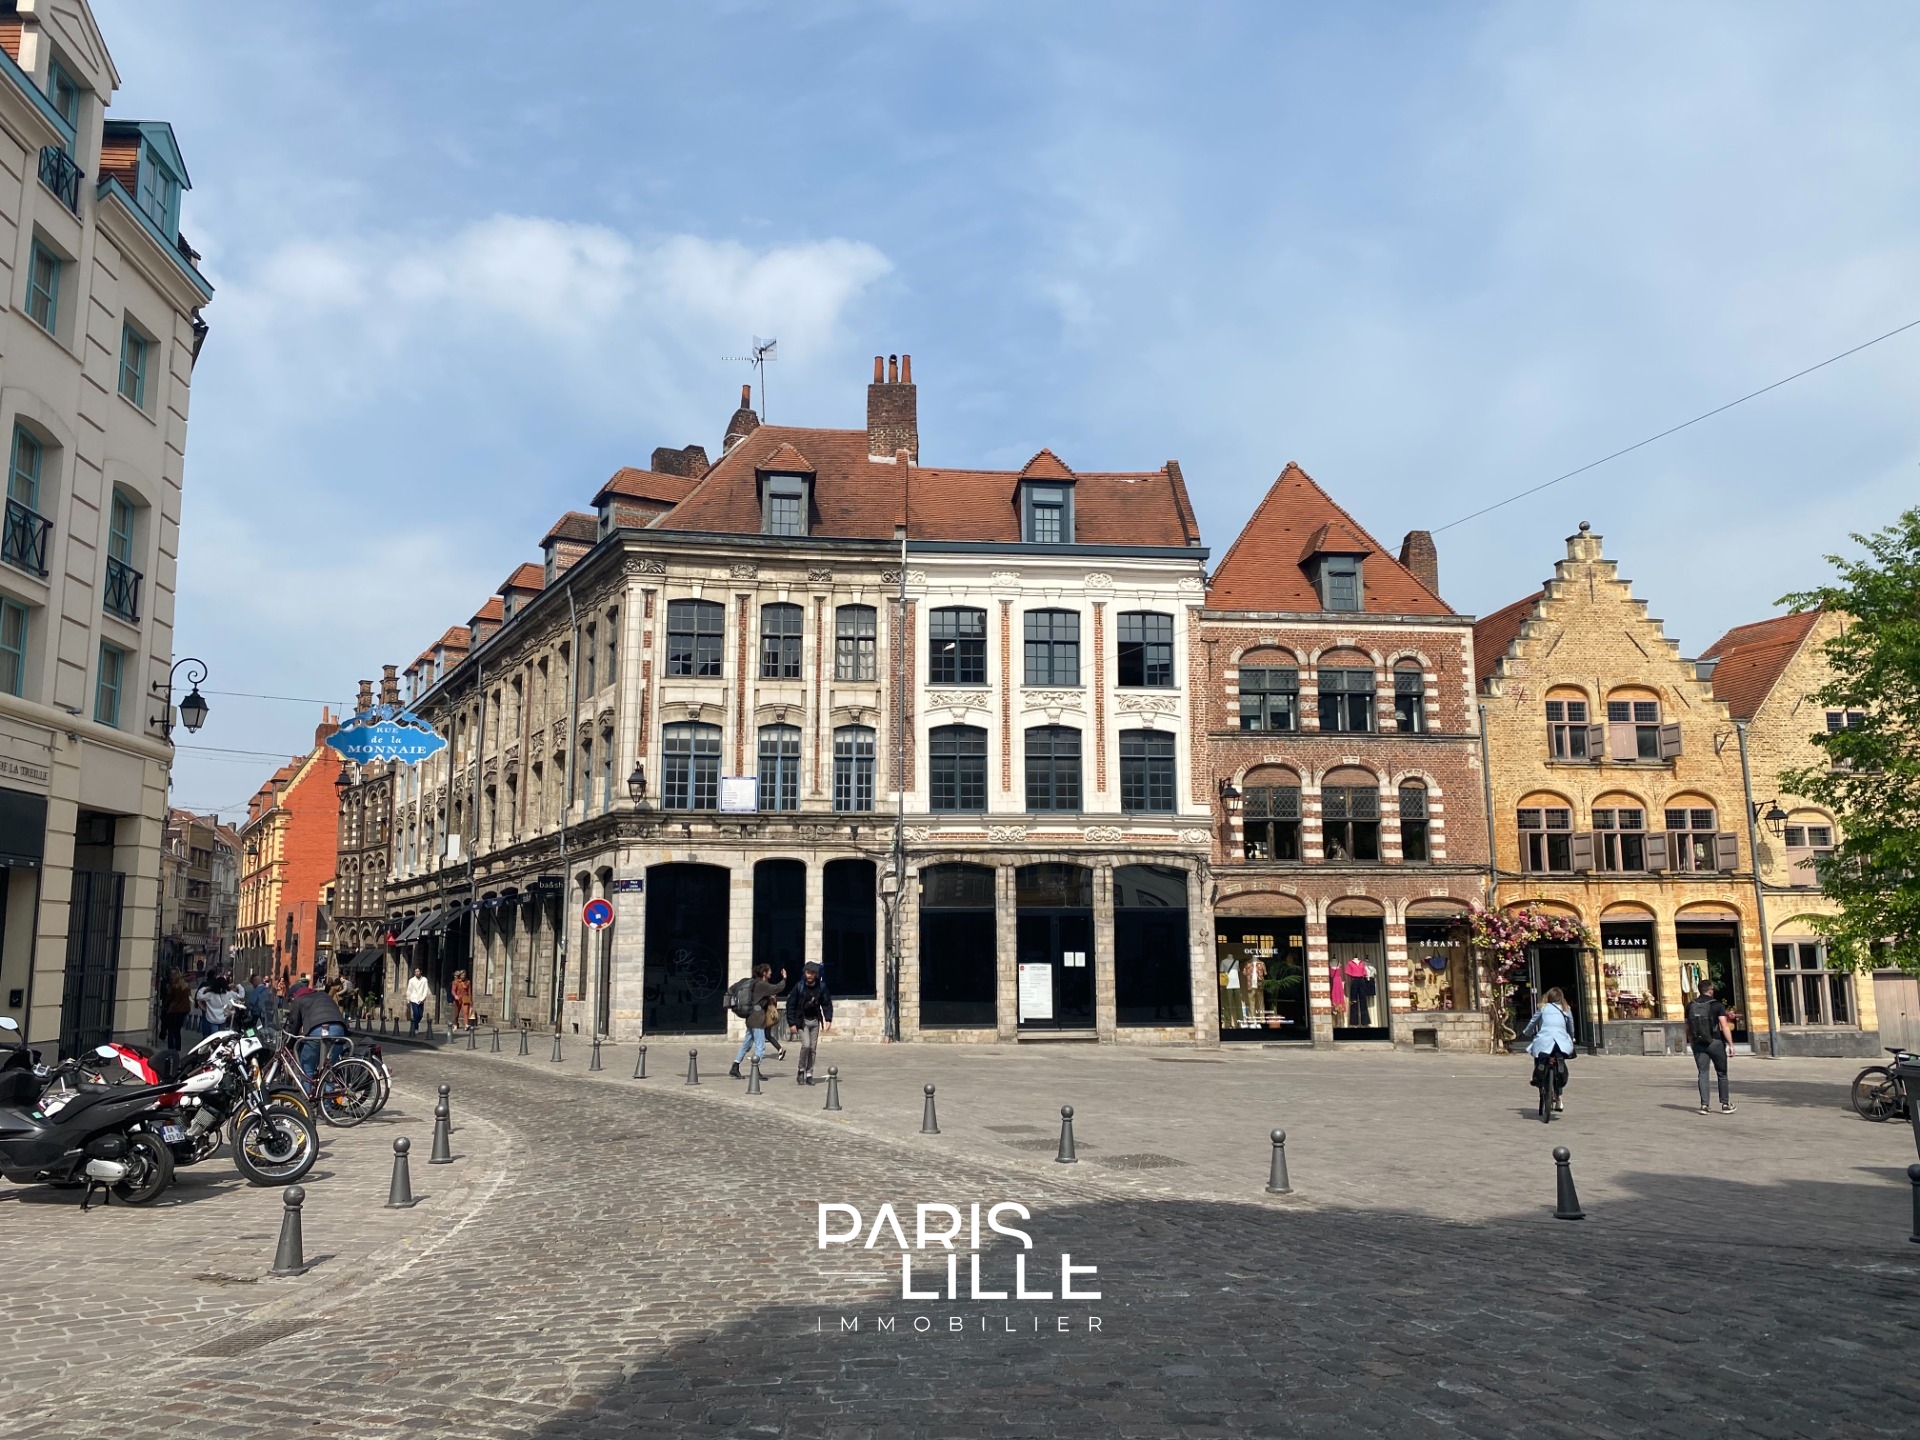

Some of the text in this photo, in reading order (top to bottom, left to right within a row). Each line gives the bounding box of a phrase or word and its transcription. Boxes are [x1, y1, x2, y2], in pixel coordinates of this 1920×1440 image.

[347, 745, 427, 754] MONNAIE
[9, 763, 19, 774] LA
[20, 766, 48, 781] TREILLE
[539, 881, 564, 889] ba&sh
[1419, 939, 1461, 948] SÉZANE
[1607, 937, 1648, 946] SÉZANE
